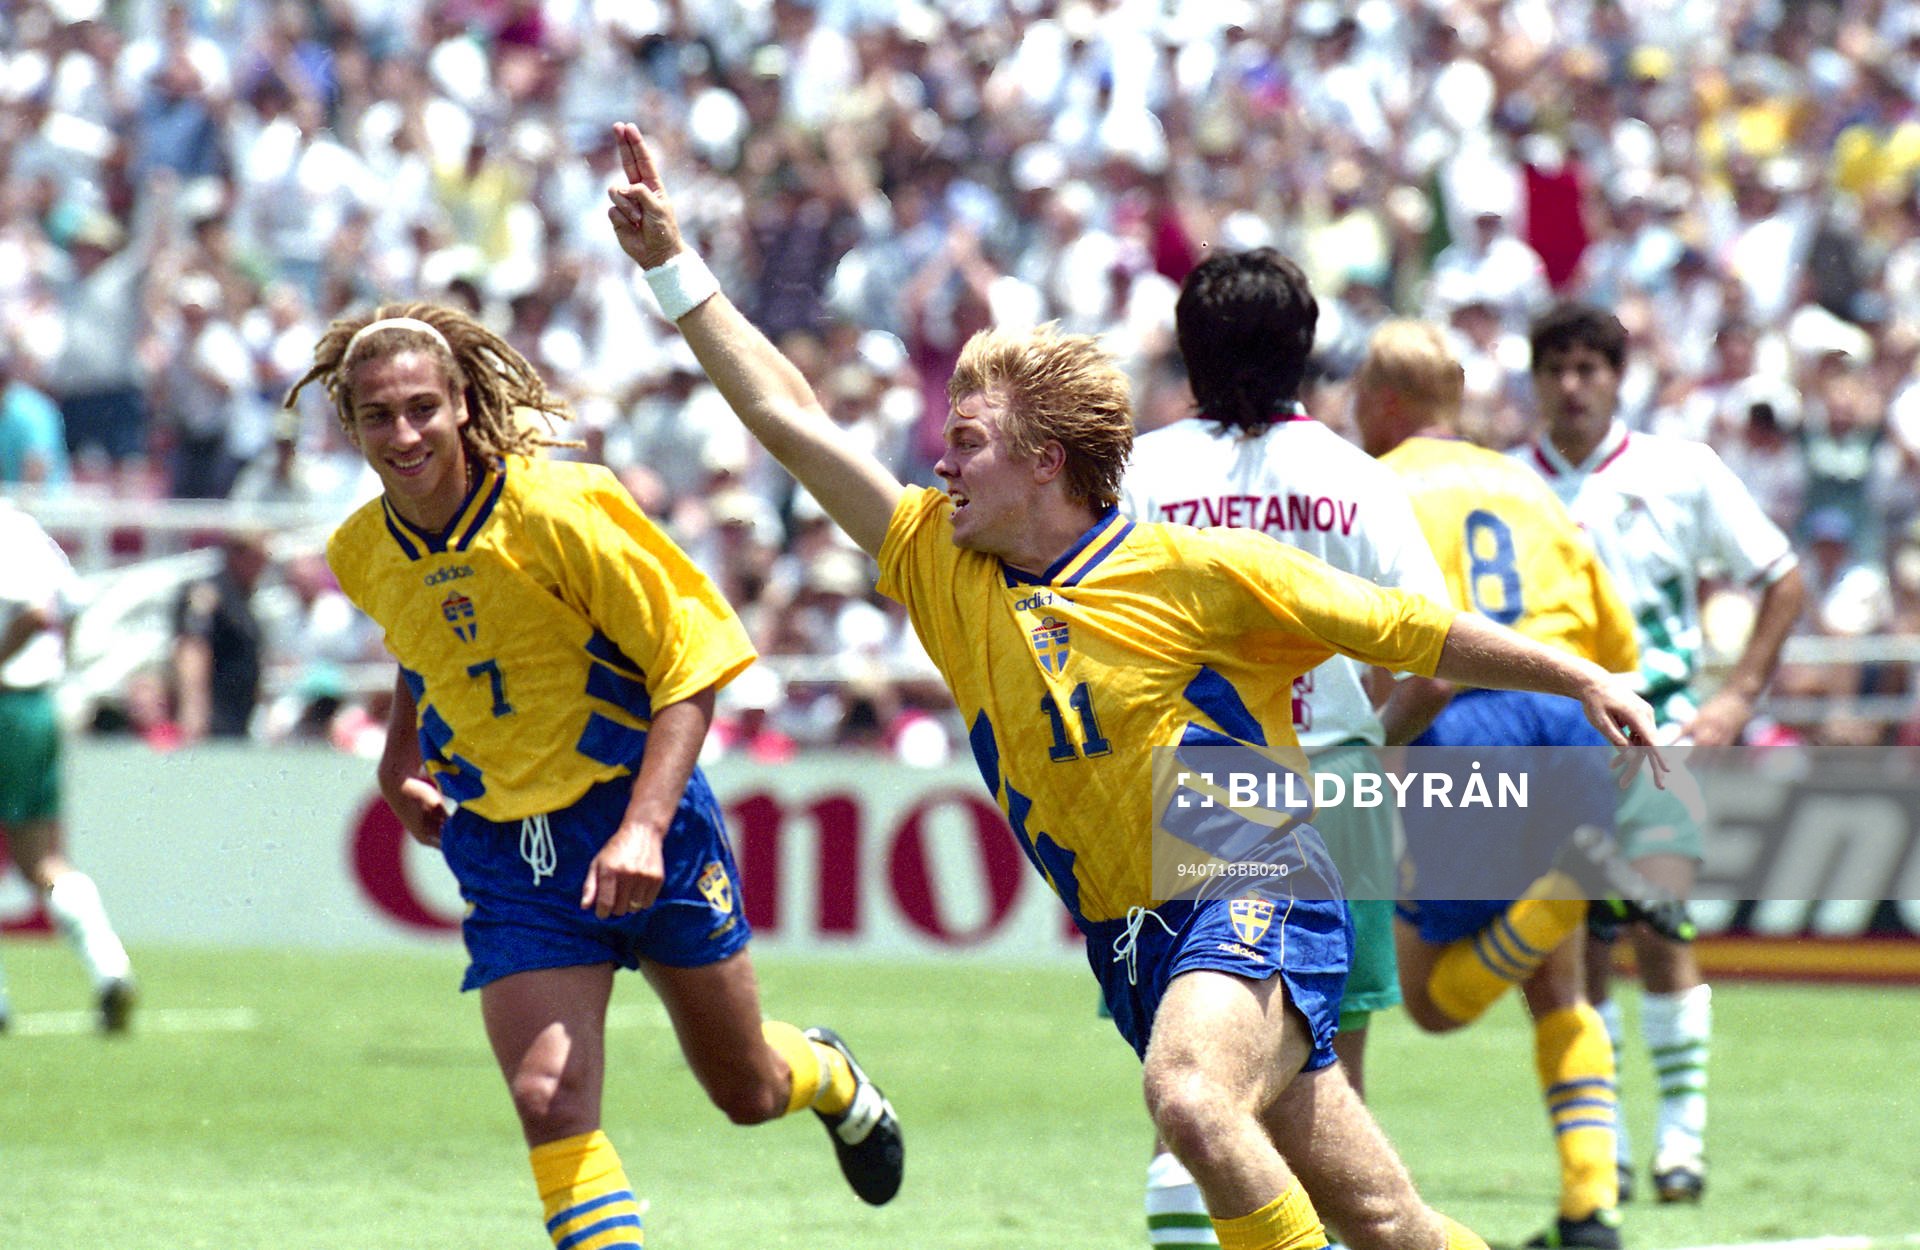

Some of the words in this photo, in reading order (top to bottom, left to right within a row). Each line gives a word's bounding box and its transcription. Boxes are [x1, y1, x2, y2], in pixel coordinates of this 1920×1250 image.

[1161, 494, 1357, 536] TZVETANOV
[424, 564, 474, 586] adidas
[1464, 508, 1526, 626] 8
[466, 658, 514, 718] 7
[1040, 681, 1113, 764] 11
